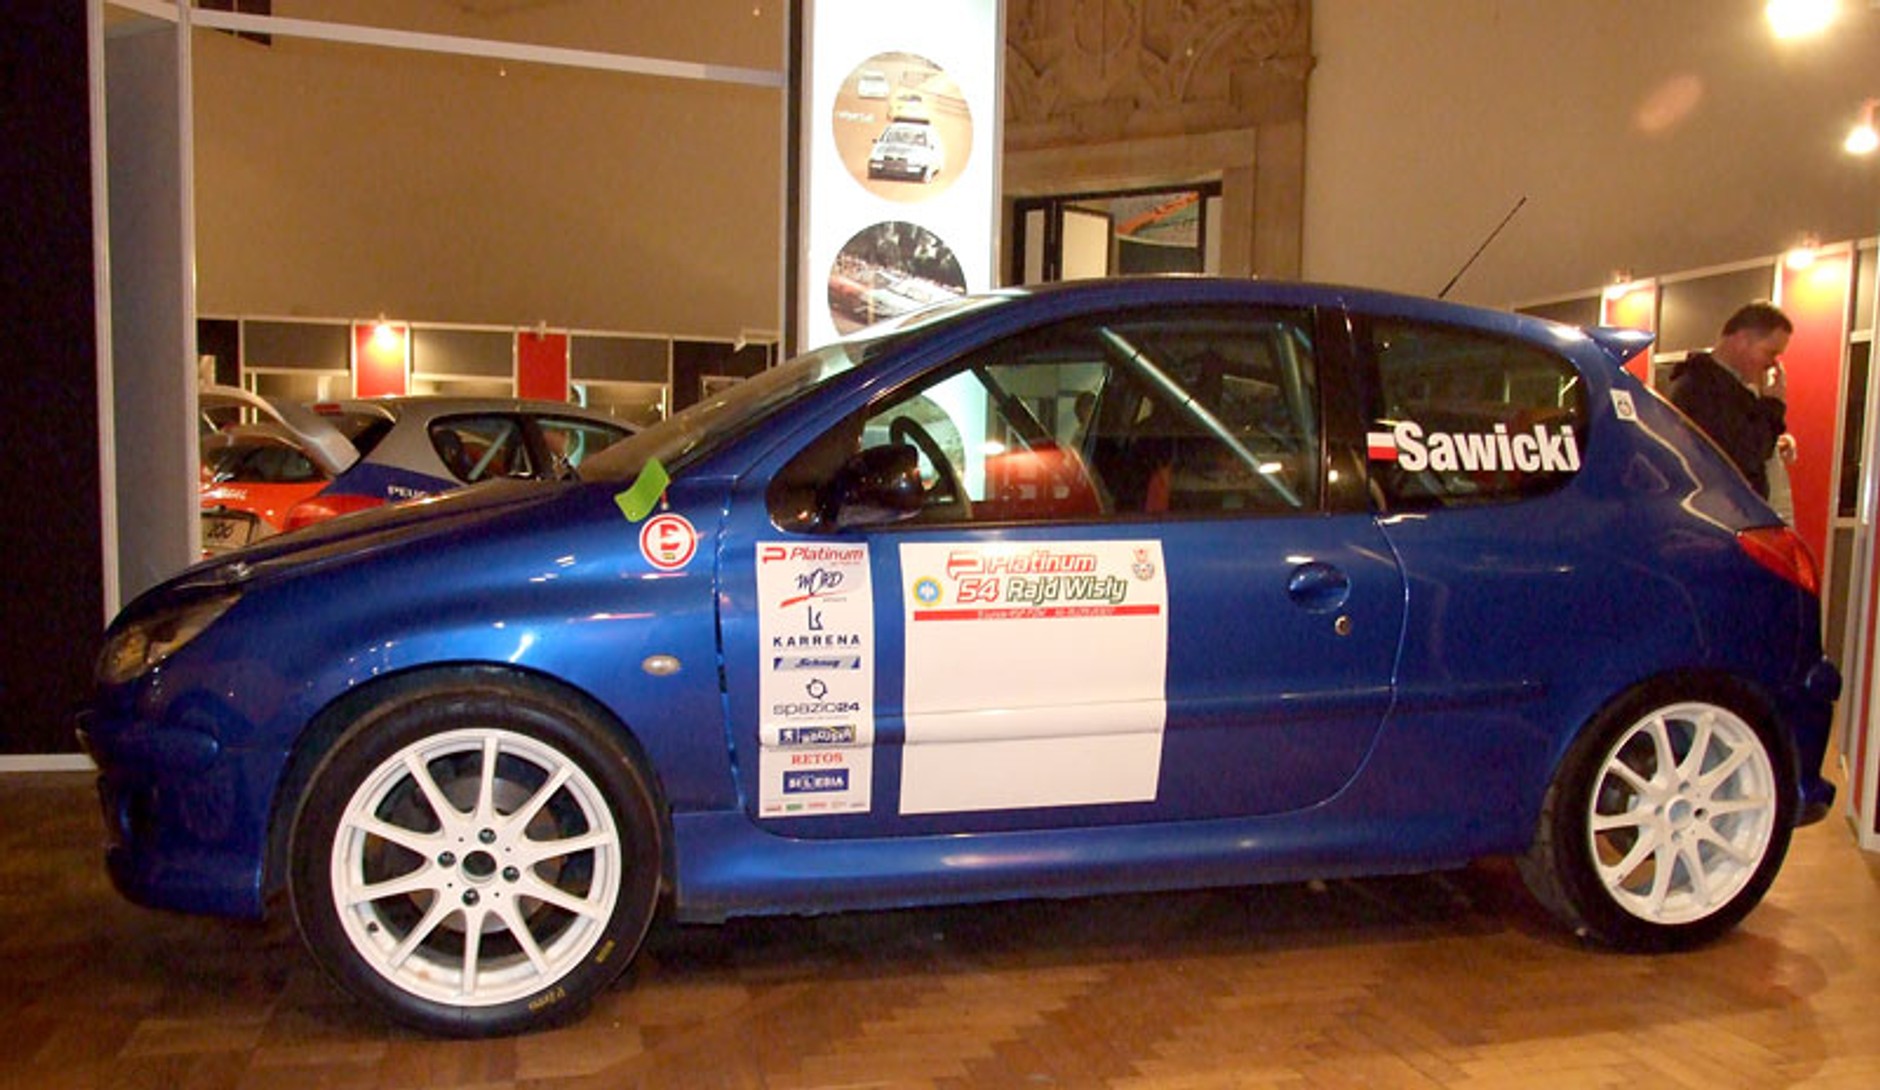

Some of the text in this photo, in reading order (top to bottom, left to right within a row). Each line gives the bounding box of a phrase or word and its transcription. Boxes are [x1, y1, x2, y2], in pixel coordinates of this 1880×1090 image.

[1394, 421, 1581, 472] Sawicki
[790, 546, 864, 562] Platinum
[987, 551, 1097, 574] Platinum
[957, 578, 999, 604] 54
[1006, 577, 1061, 607] Rajd
[773, 634, 860, 647] KARRENA
[773, 701, 861, 718] spazio24
[791, 752, 844, 765] RETOS
